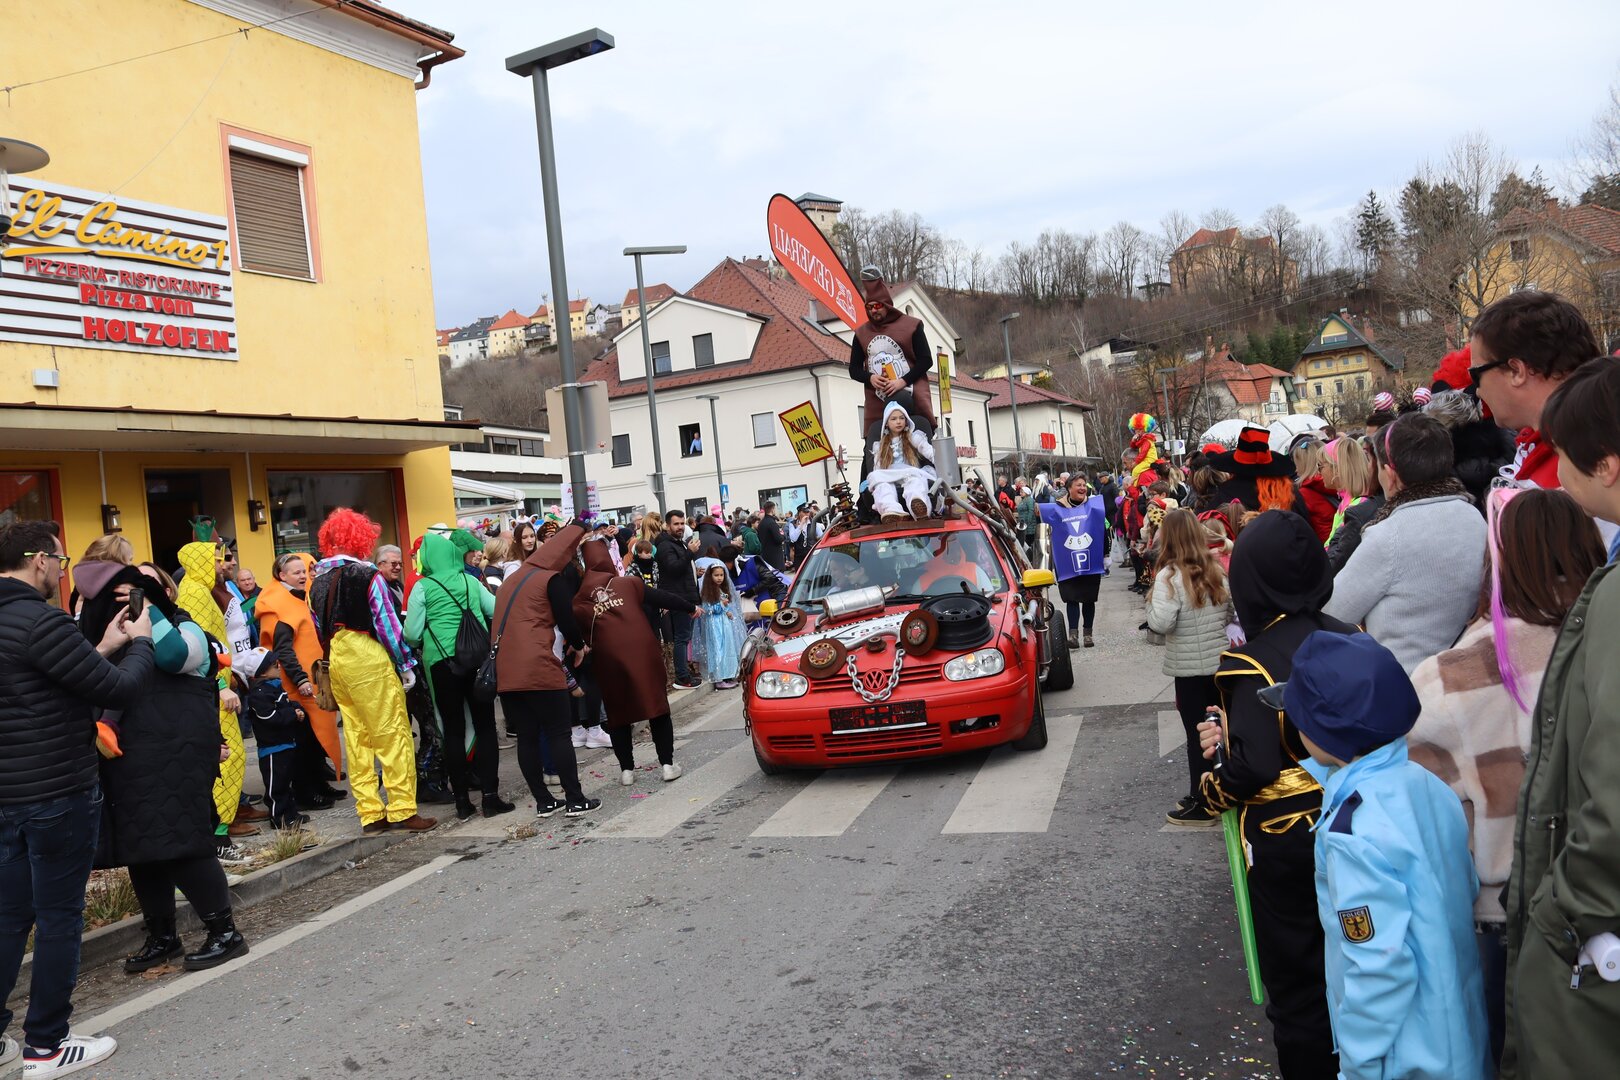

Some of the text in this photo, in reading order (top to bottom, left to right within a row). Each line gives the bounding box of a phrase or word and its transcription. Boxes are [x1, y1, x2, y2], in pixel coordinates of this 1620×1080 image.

[7, 189, 67, 238] El
[75, 201, 208, 263] Camino
[118, 270, 221, 298] RISTORANTE
[79, 282, 195, 317] Pizza vom
[82, 315, 230, 352] HOLZOFEN
[1068, 537, 1073, 545] 5
[1077, 537, 1082, 545] 6
[1076, 552, 1087, 569] P
[234, 637, 252, 653] BIE
[1342, 910, 1365, 918] POLICE
